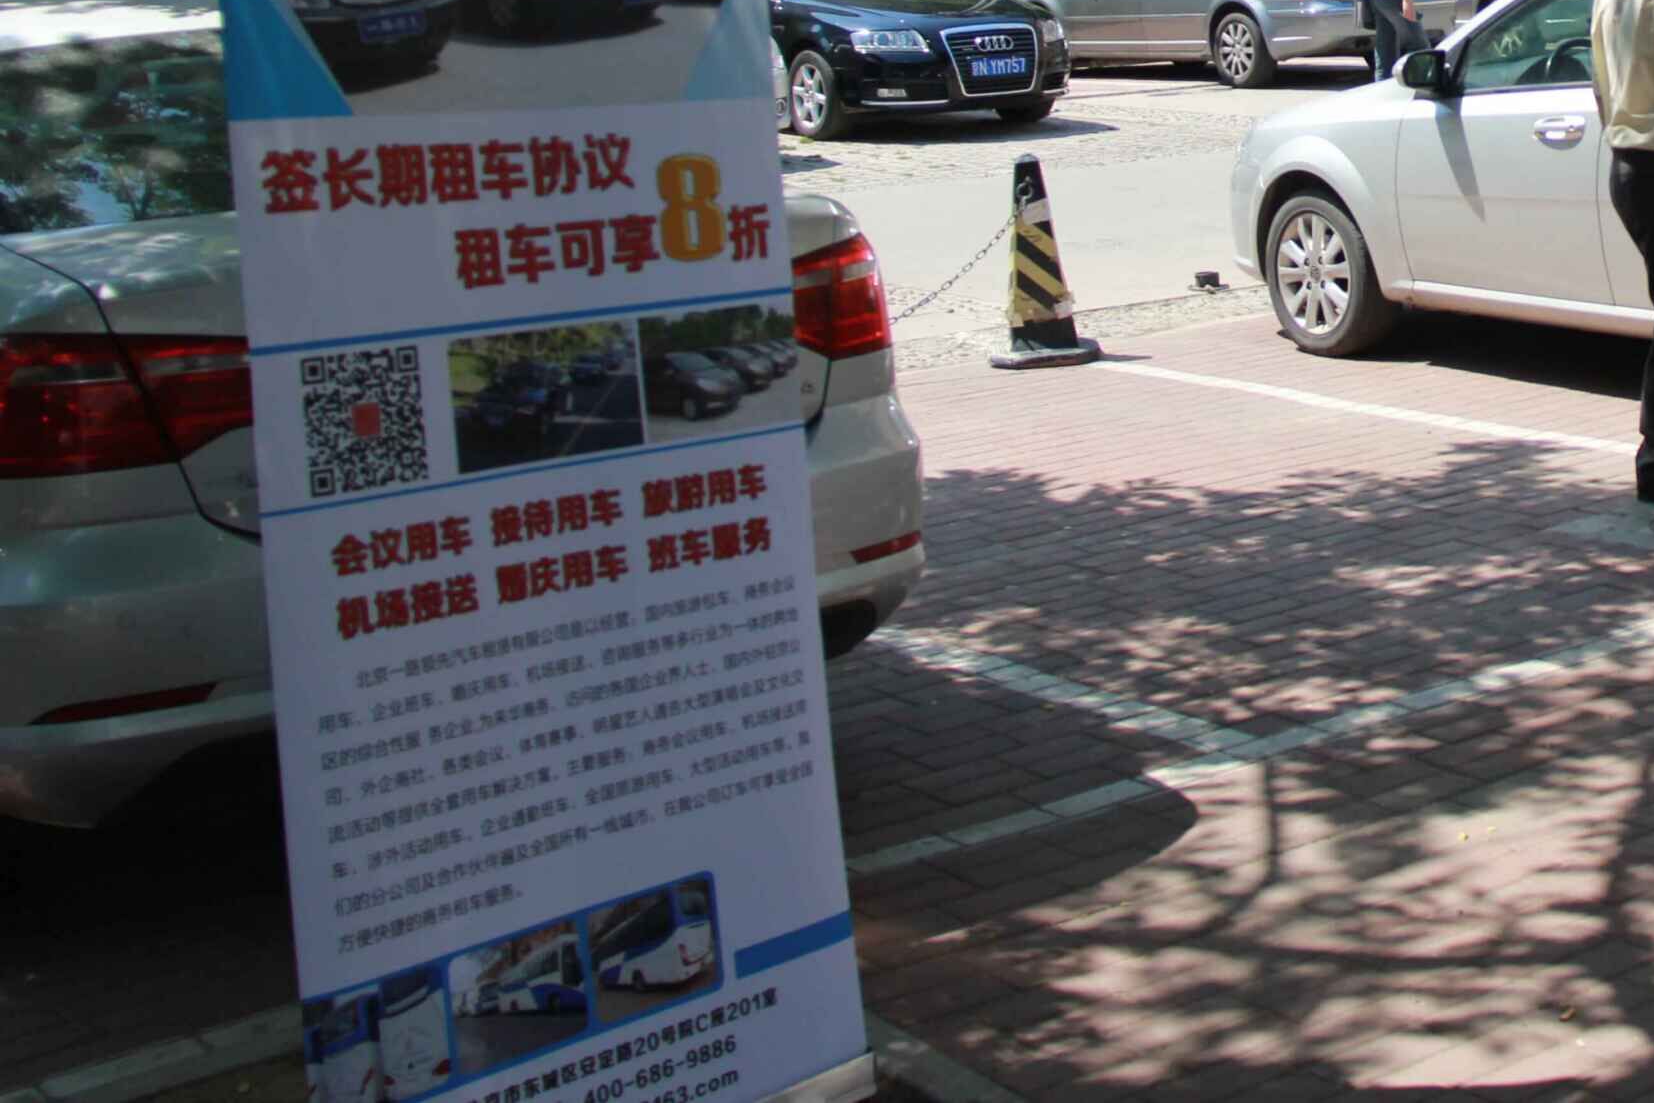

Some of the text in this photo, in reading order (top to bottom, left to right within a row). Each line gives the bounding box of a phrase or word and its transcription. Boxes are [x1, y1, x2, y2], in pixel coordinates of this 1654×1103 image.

[261, 133, 634, 215] 签长期租车协议
[332, 463, 768, 577] 会议用车 接待用车 旅游用车
[337, 516, 772, 640] 机场接送 婚庆用车 班车服务
[583, 1035, 737, 1103] 400-686-9886
